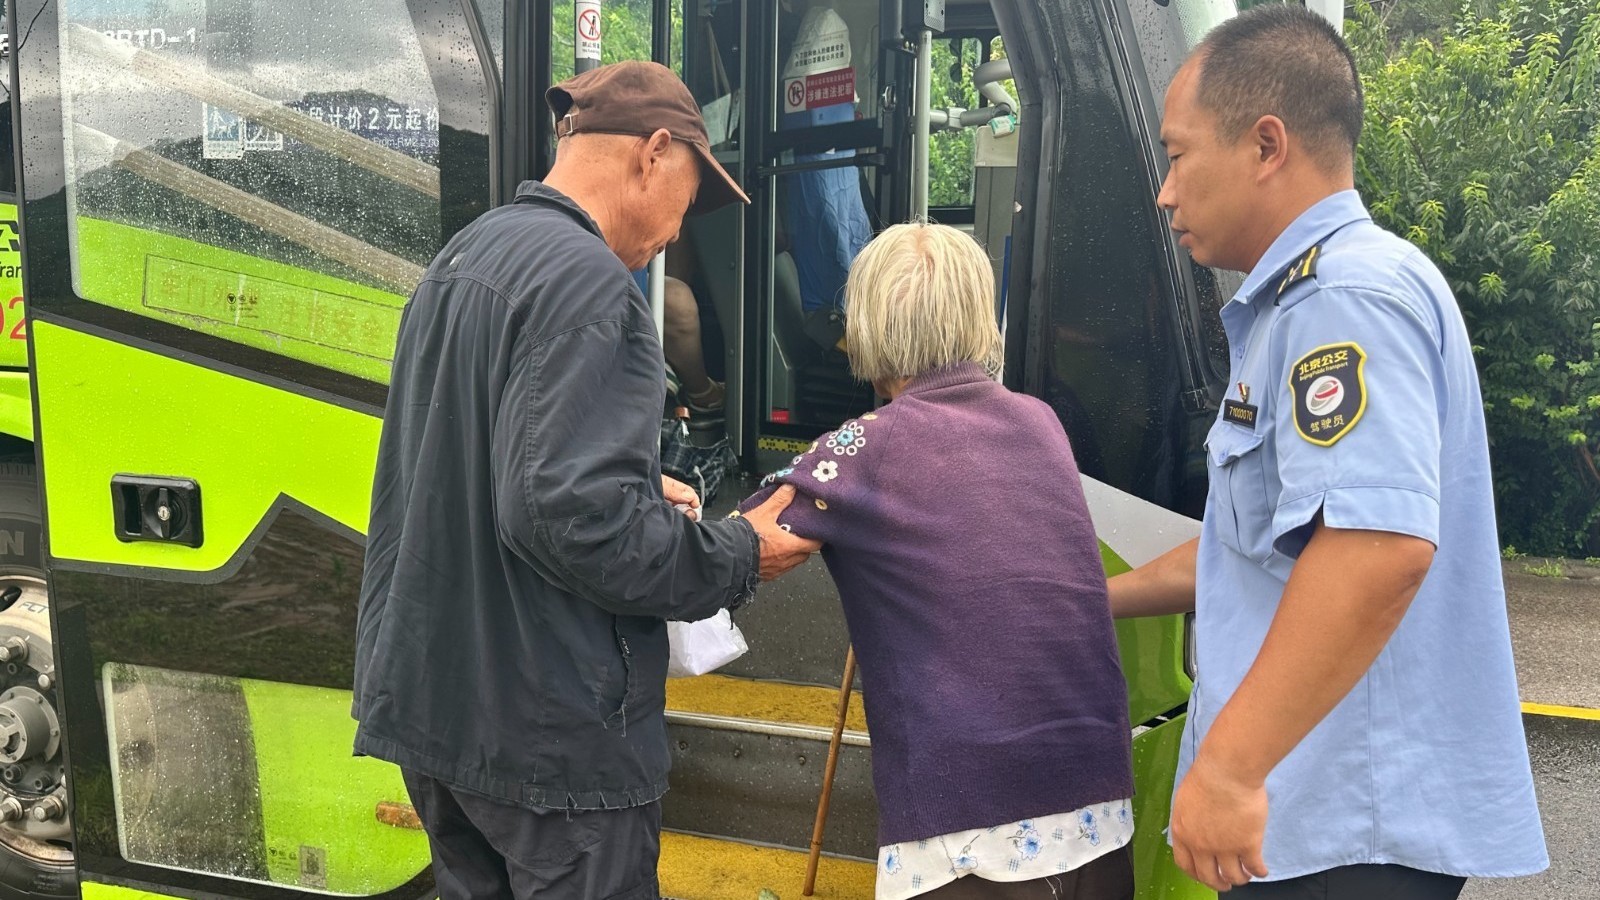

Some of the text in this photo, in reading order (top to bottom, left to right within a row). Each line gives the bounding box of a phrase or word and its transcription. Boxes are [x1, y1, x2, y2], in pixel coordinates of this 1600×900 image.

[807, 82, 852, 102] 涉嫌违法犯罪
[292, 106, 439, 132] 段计价2元起价
[1299, 350, 1348, 376] 北京公交
[1325, 361, 1348, 371] Transport
[1310, 414, 1345, 433] 驾驶员
